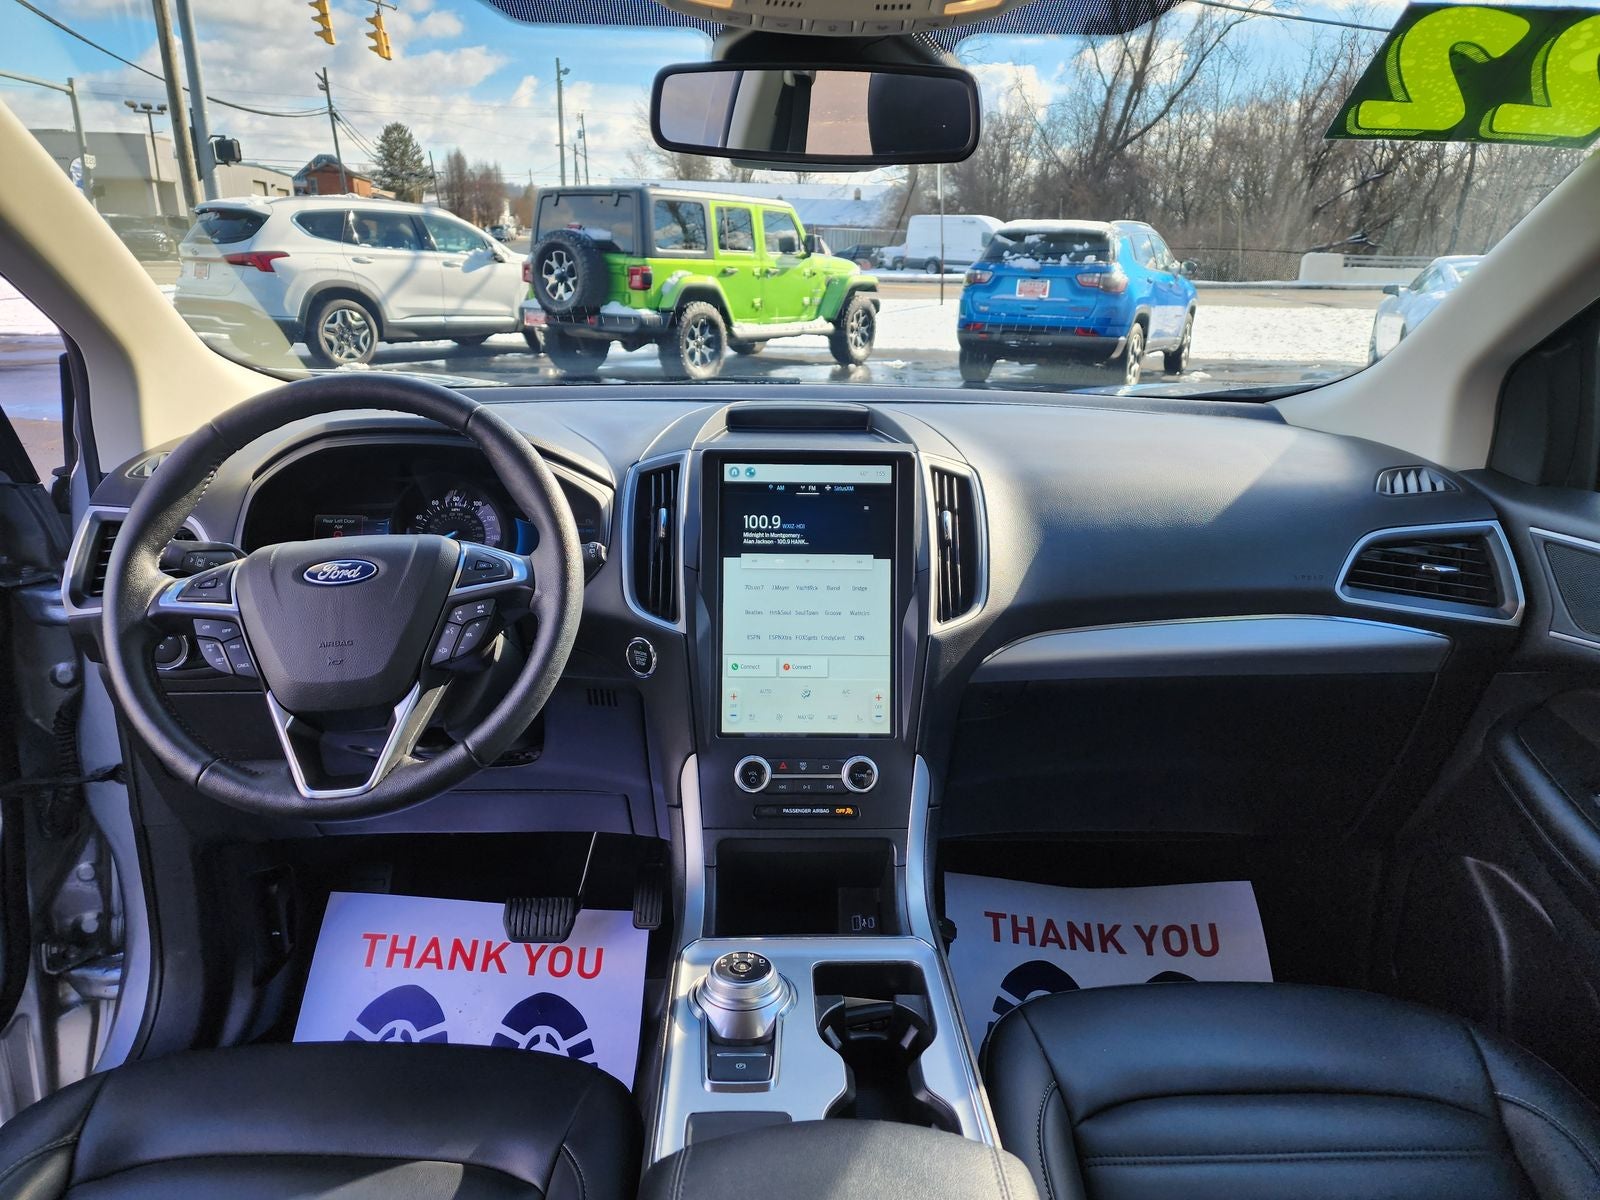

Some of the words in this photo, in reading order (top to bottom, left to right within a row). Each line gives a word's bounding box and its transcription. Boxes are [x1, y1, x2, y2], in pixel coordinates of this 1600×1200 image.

[743, 515, 781, 529] 100.9
[317, 563, 362, 580] Ford
[319, 640, 353, 648] AIRBAG
[984, 911, 1127, 955] THANK
[1134, 923, 1220, 957] YOU
[361, 933, 512, 975] THANK
[523, 944, 604, 980] YOU
